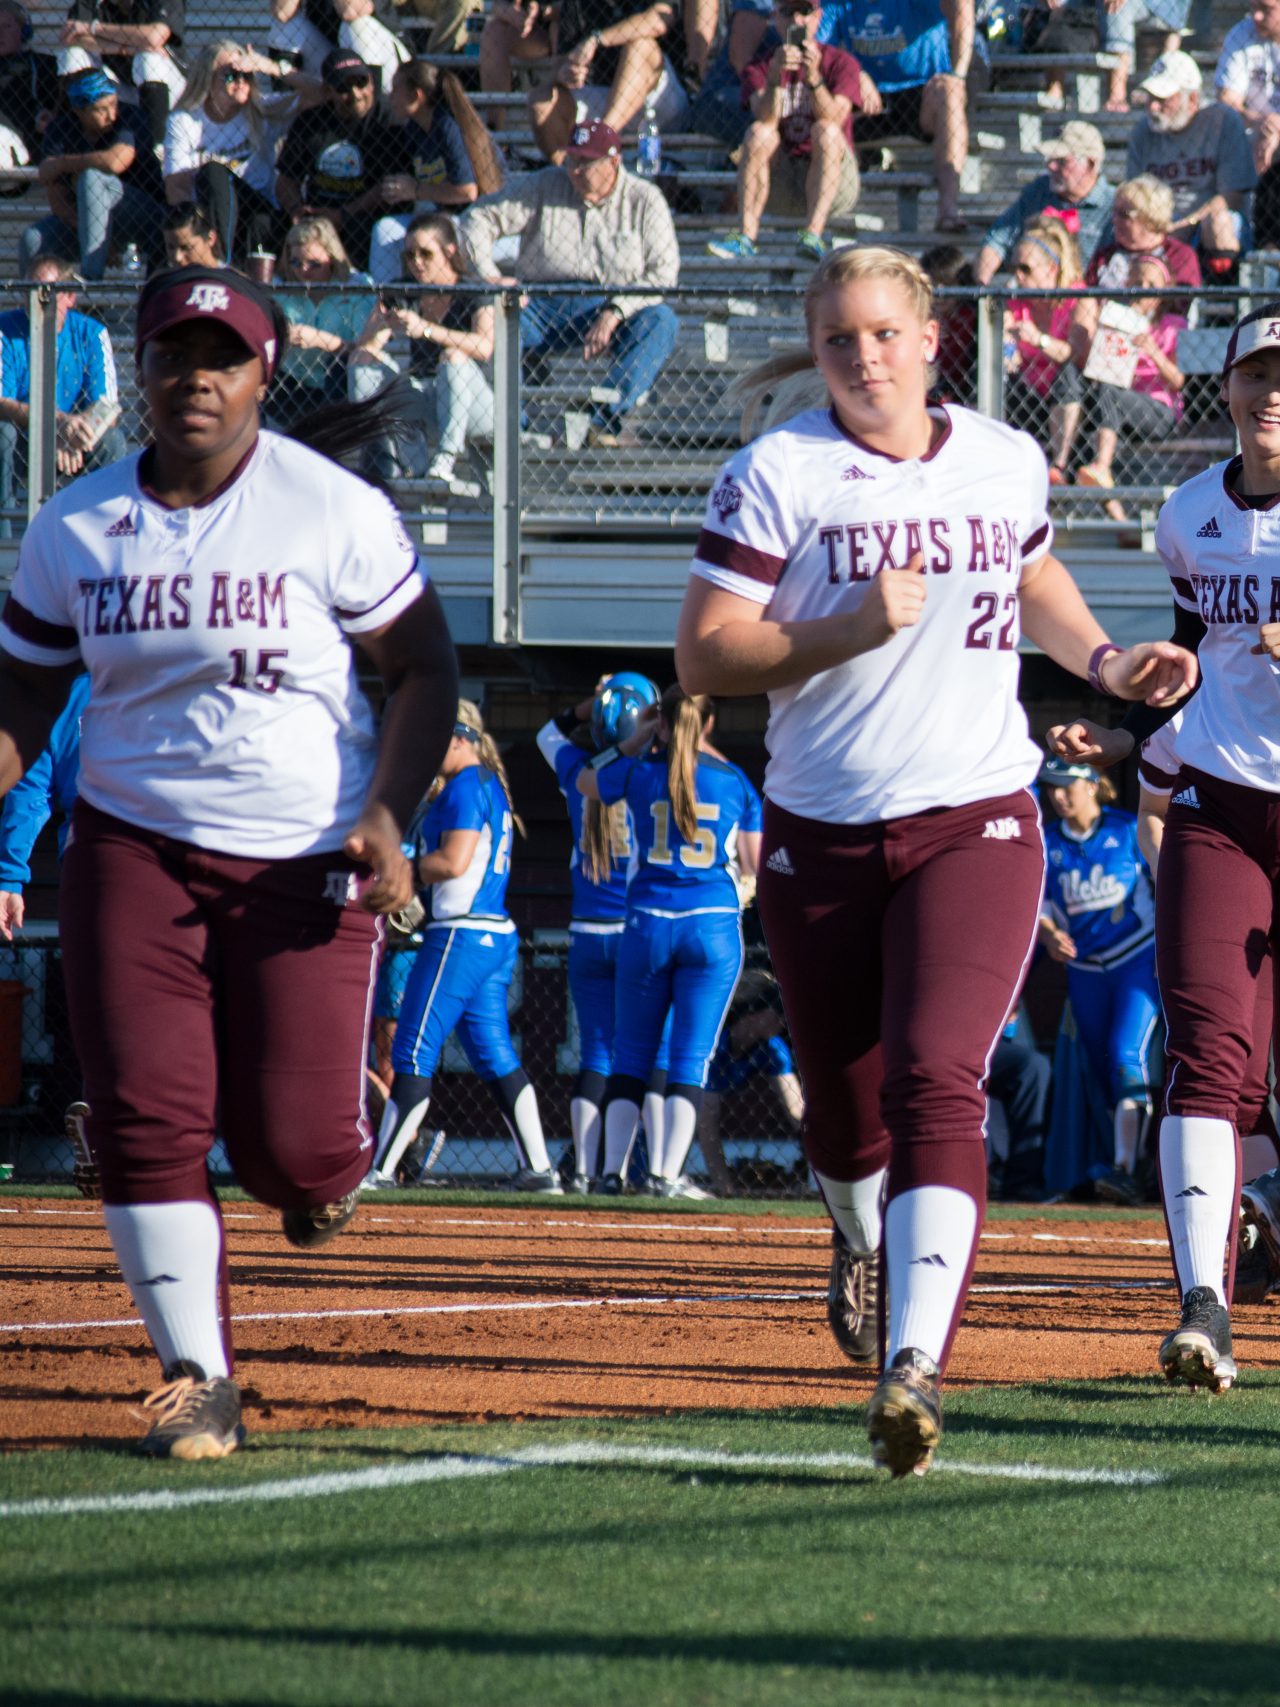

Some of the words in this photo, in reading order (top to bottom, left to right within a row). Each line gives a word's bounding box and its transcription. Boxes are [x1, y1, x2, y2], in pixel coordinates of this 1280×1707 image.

[819, 518, 953, 584] TEXAS
[966, 515, 1020, 575] A&M
[79, 574, 193, 636] TEXAS
[206, 571, 289, 629] A&M
[964, 591, 1020, 650] 22
[1190, 574, 1260, 625] TEXAS
[229, 648, 288, 694] 15
[647, 801, 721, 869] 15
